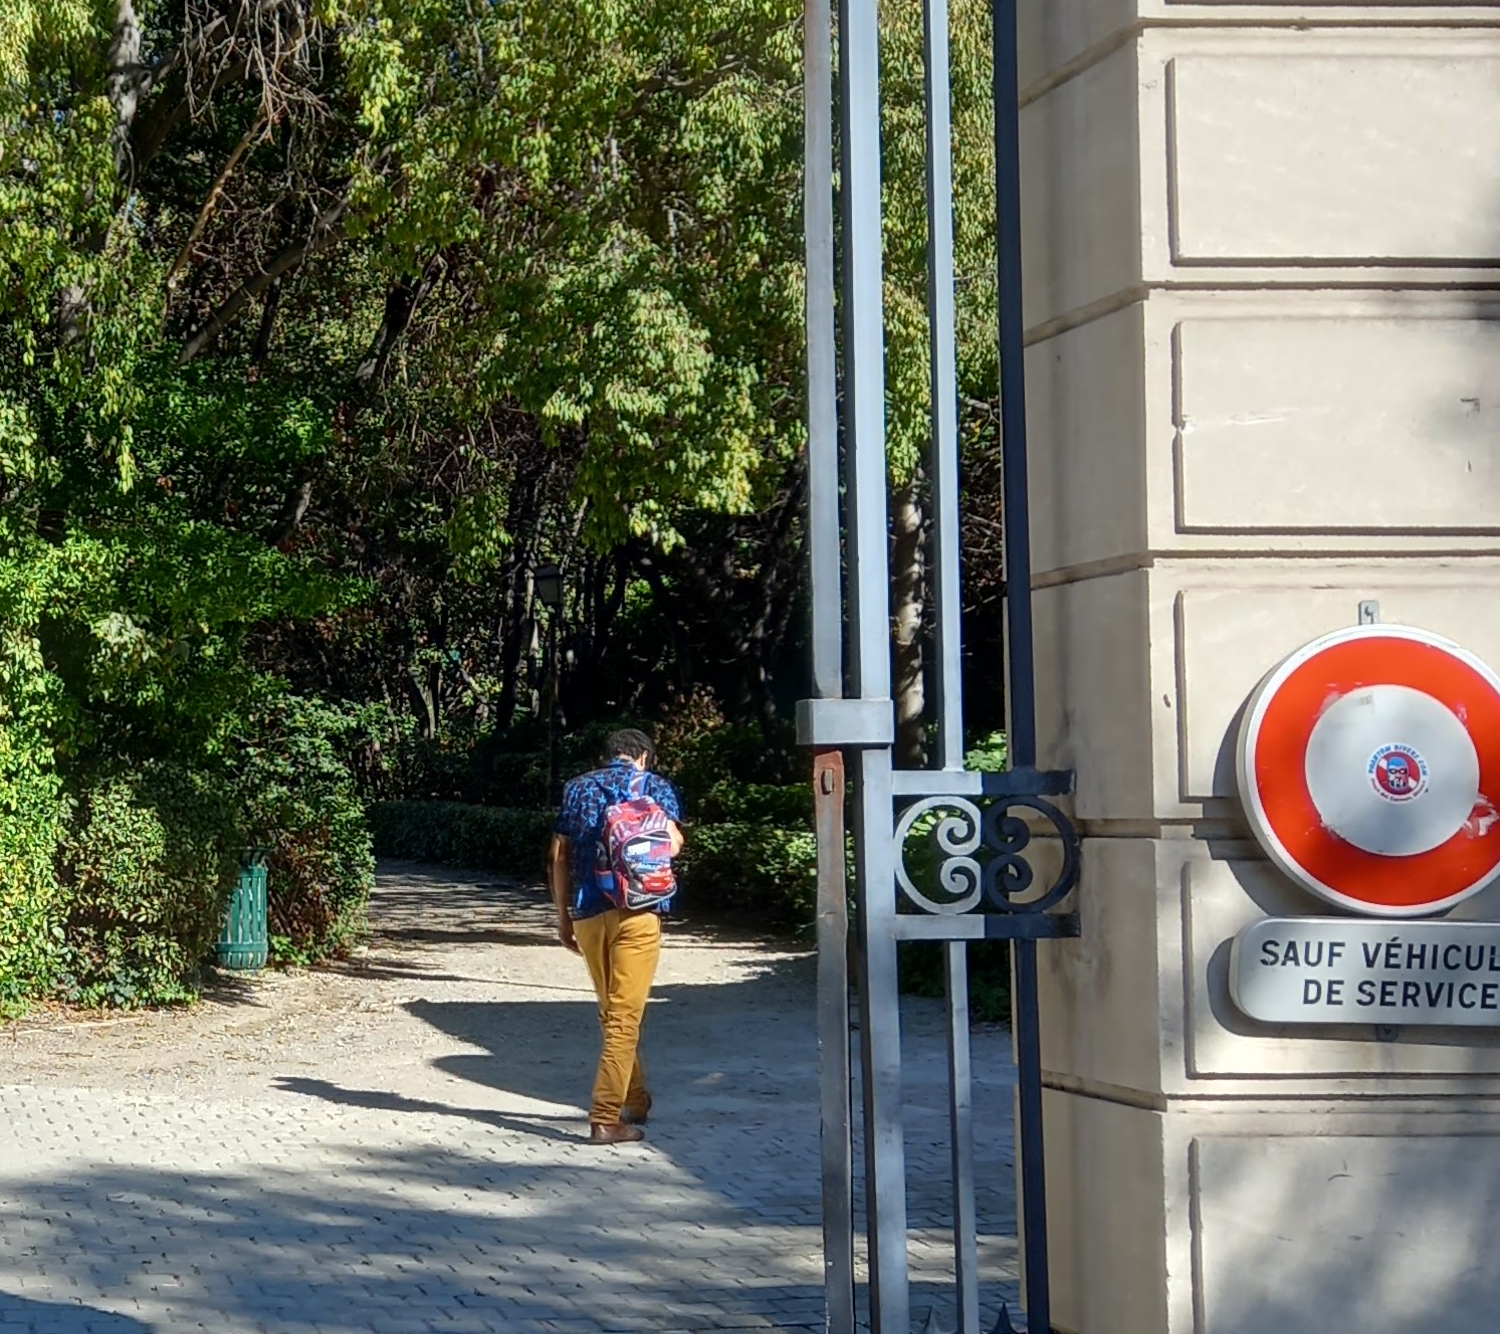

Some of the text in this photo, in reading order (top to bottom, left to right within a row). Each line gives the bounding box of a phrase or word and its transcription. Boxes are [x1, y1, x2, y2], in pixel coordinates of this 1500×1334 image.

[1259, 939, 1346, 967] SAUF
[1302, 978, 1499, 1010] DE SERVICE
